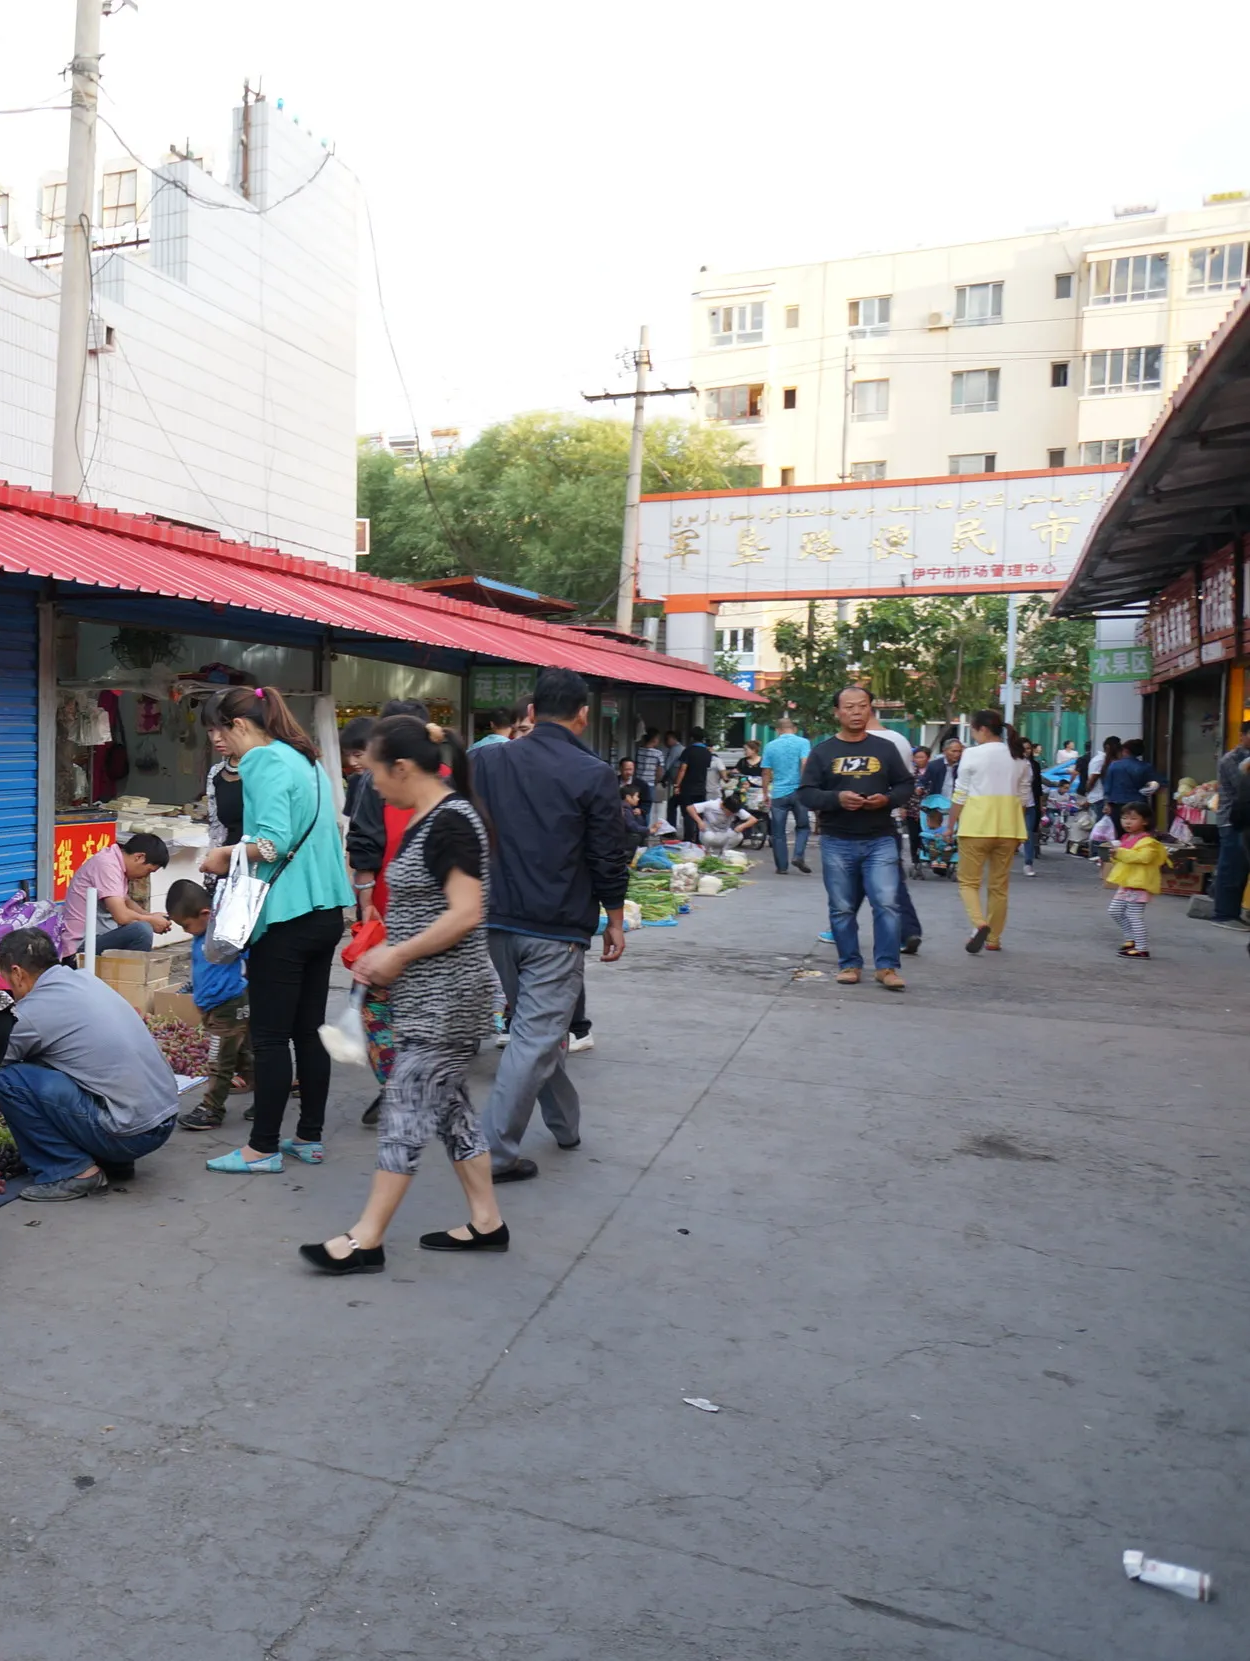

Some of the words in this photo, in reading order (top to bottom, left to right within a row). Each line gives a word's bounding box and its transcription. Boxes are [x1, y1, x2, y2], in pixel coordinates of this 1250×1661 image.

[912, 563, 1057, 580] 伊宁市市场管理中心
[1094, 651, 1147, 676] 水果区
